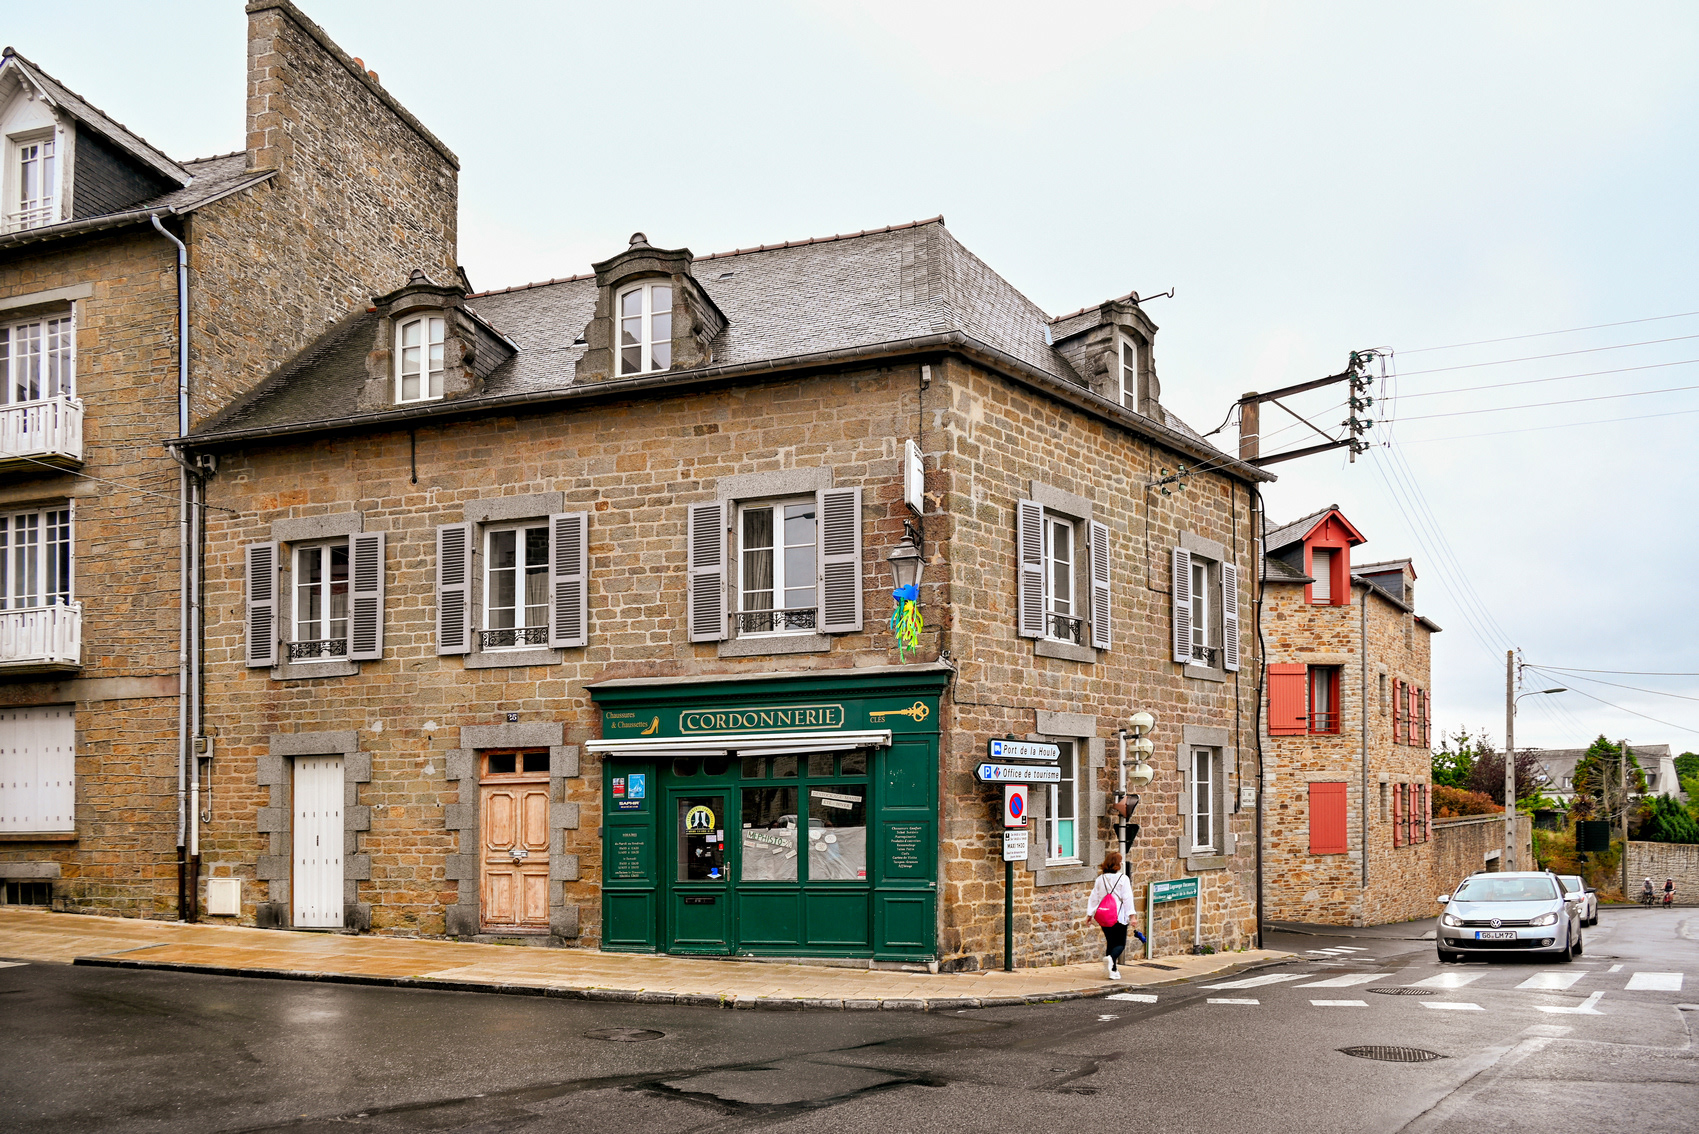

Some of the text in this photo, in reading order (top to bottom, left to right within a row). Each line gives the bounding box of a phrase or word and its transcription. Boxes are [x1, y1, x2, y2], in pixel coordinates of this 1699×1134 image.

[687, 709, 836, 728] CORDONNERIE
[1003, 745, 1056, 757] Port de la Houle
[985, 767, 1059, 779] P Office de tourisme
